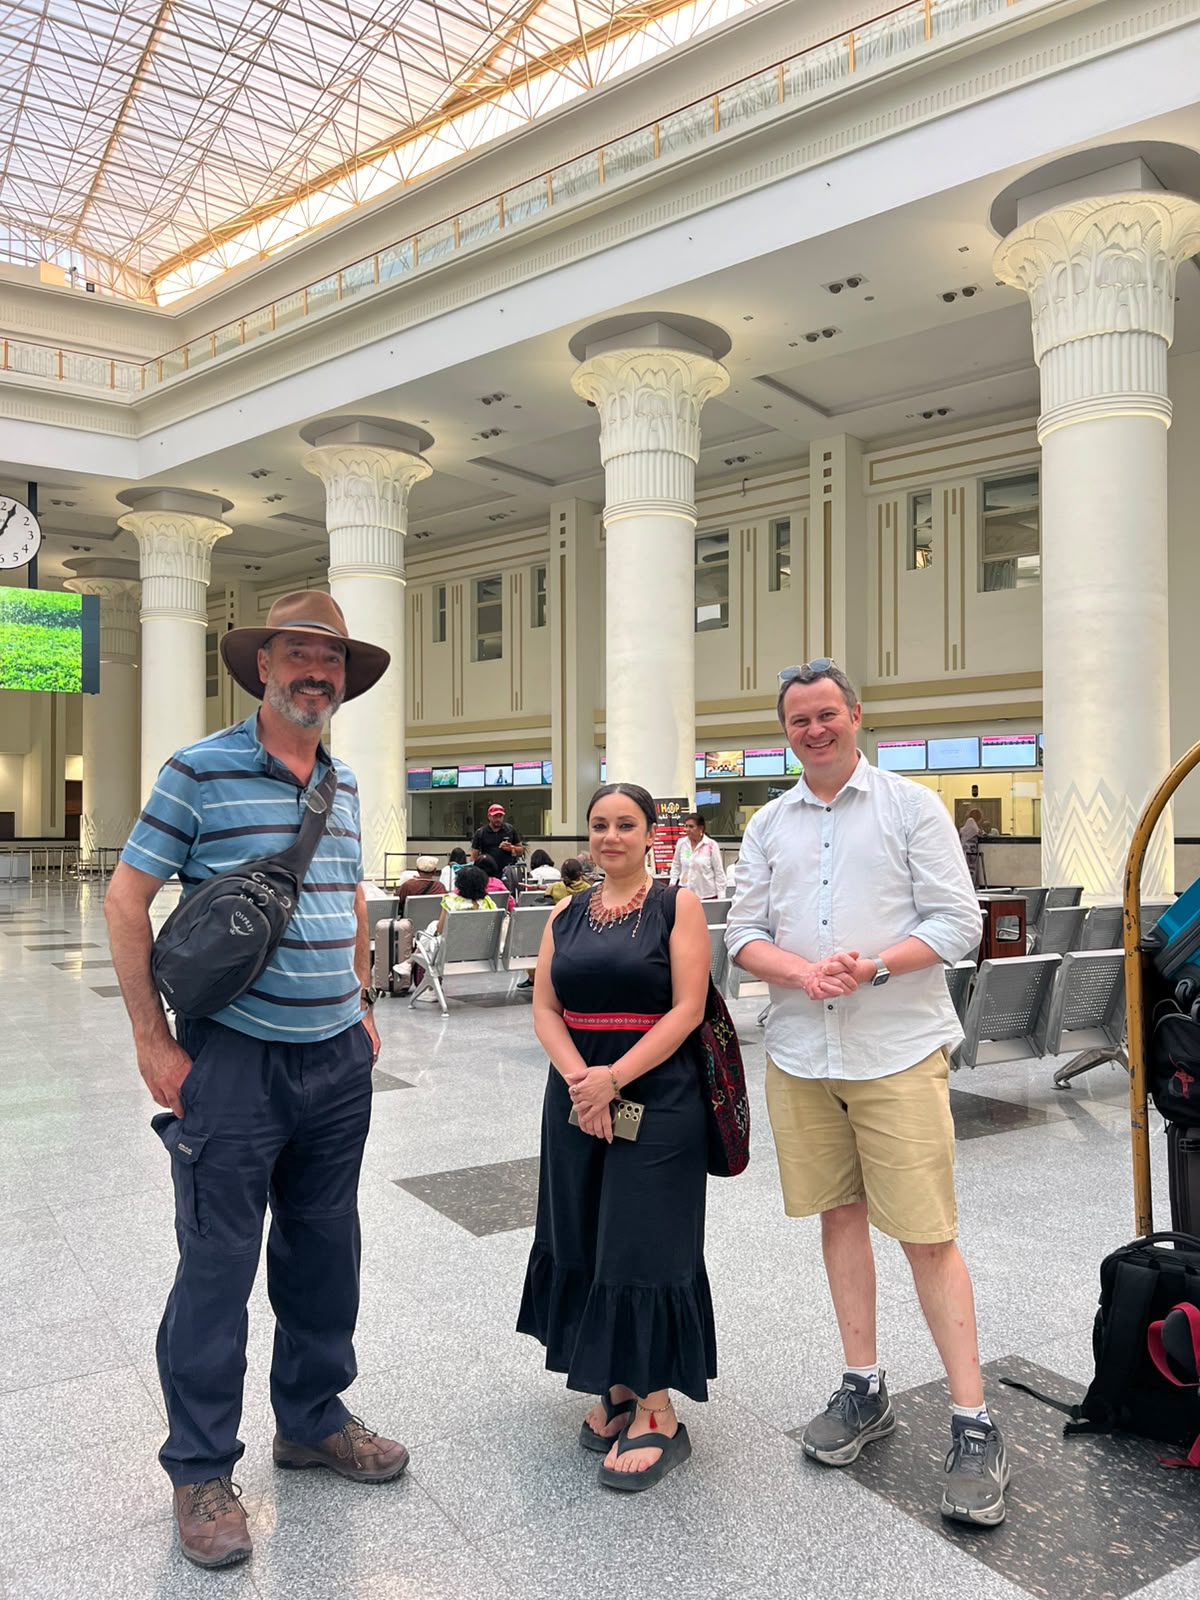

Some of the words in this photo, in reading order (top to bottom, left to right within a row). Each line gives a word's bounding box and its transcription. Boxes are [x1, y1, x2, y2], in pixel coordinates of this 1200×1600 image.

[0, 501, 7, 510] 2
[24, 517, 30, 526] 2
[28, 531, 34, 540] 3
[22, 544, 29, 553] 4
[13, 552, 19, 561] 5
[235, 911, 254, 932] OSPREY
